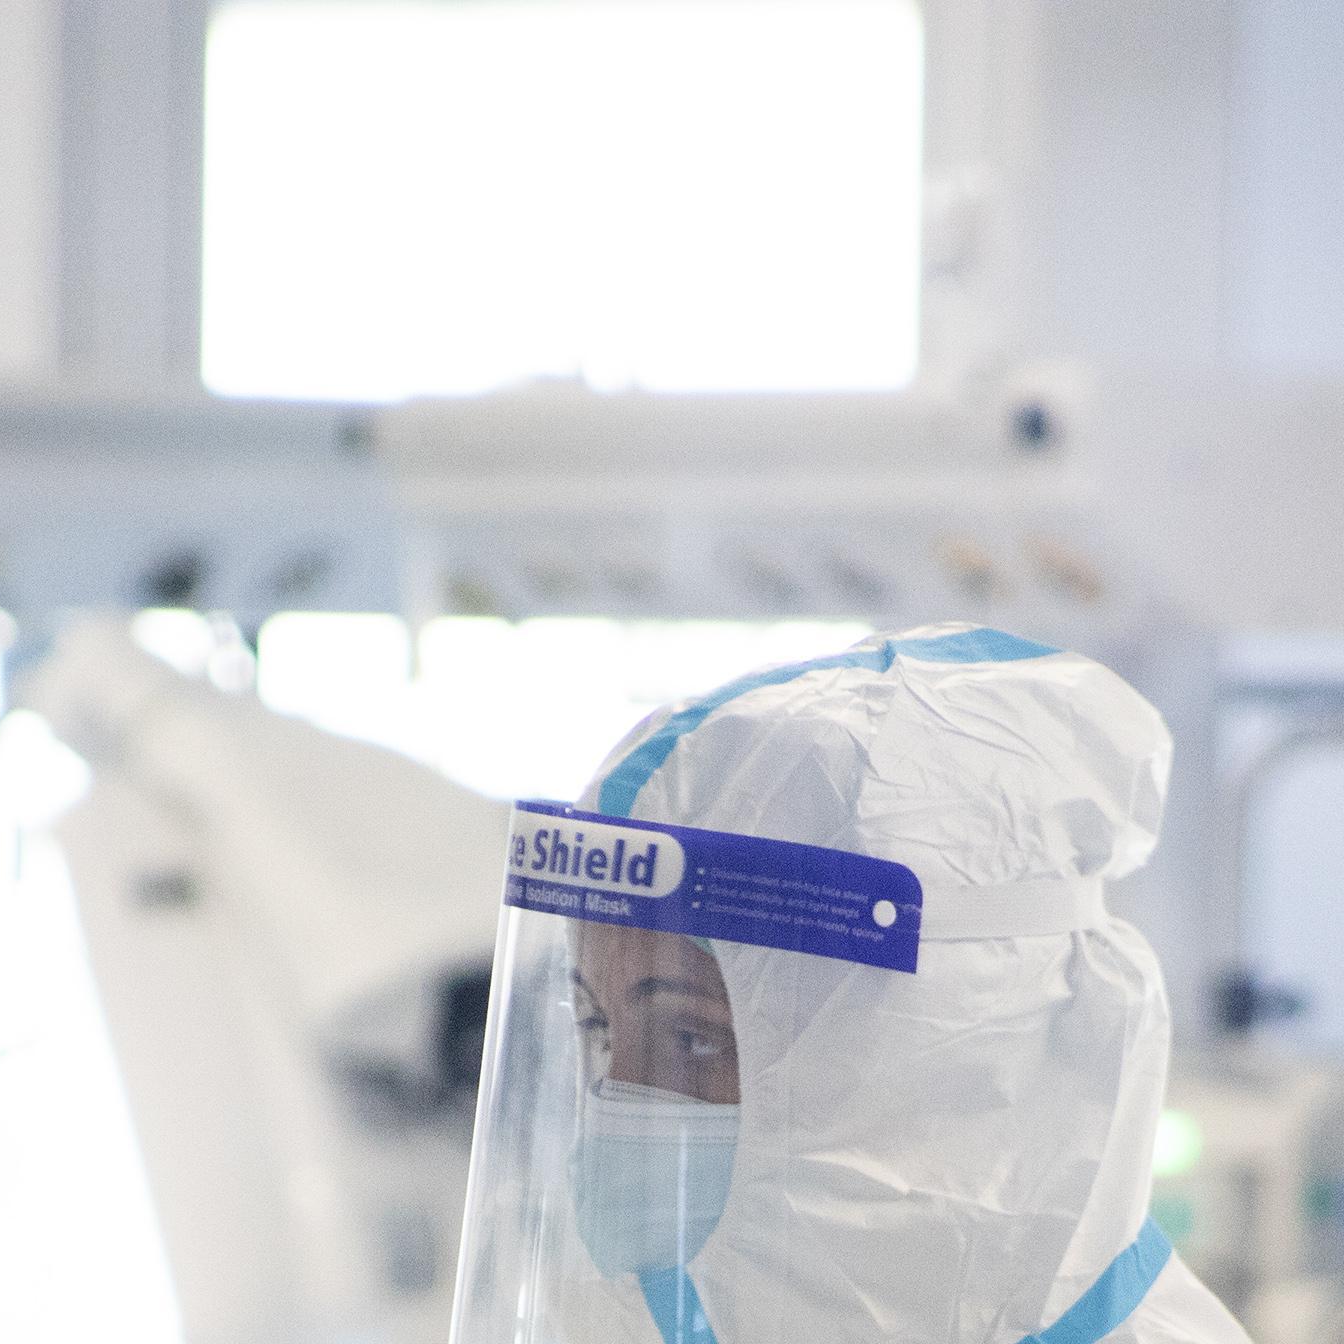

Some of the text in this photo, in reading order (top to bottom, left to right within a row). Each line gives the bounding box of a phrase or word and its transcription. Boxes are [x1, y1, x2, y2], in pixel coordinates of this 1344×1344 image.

[531, 829, 658, 887] Shield
[525, 882, 582, 908] Isolation
[585, 892, 632, 917] Mask
